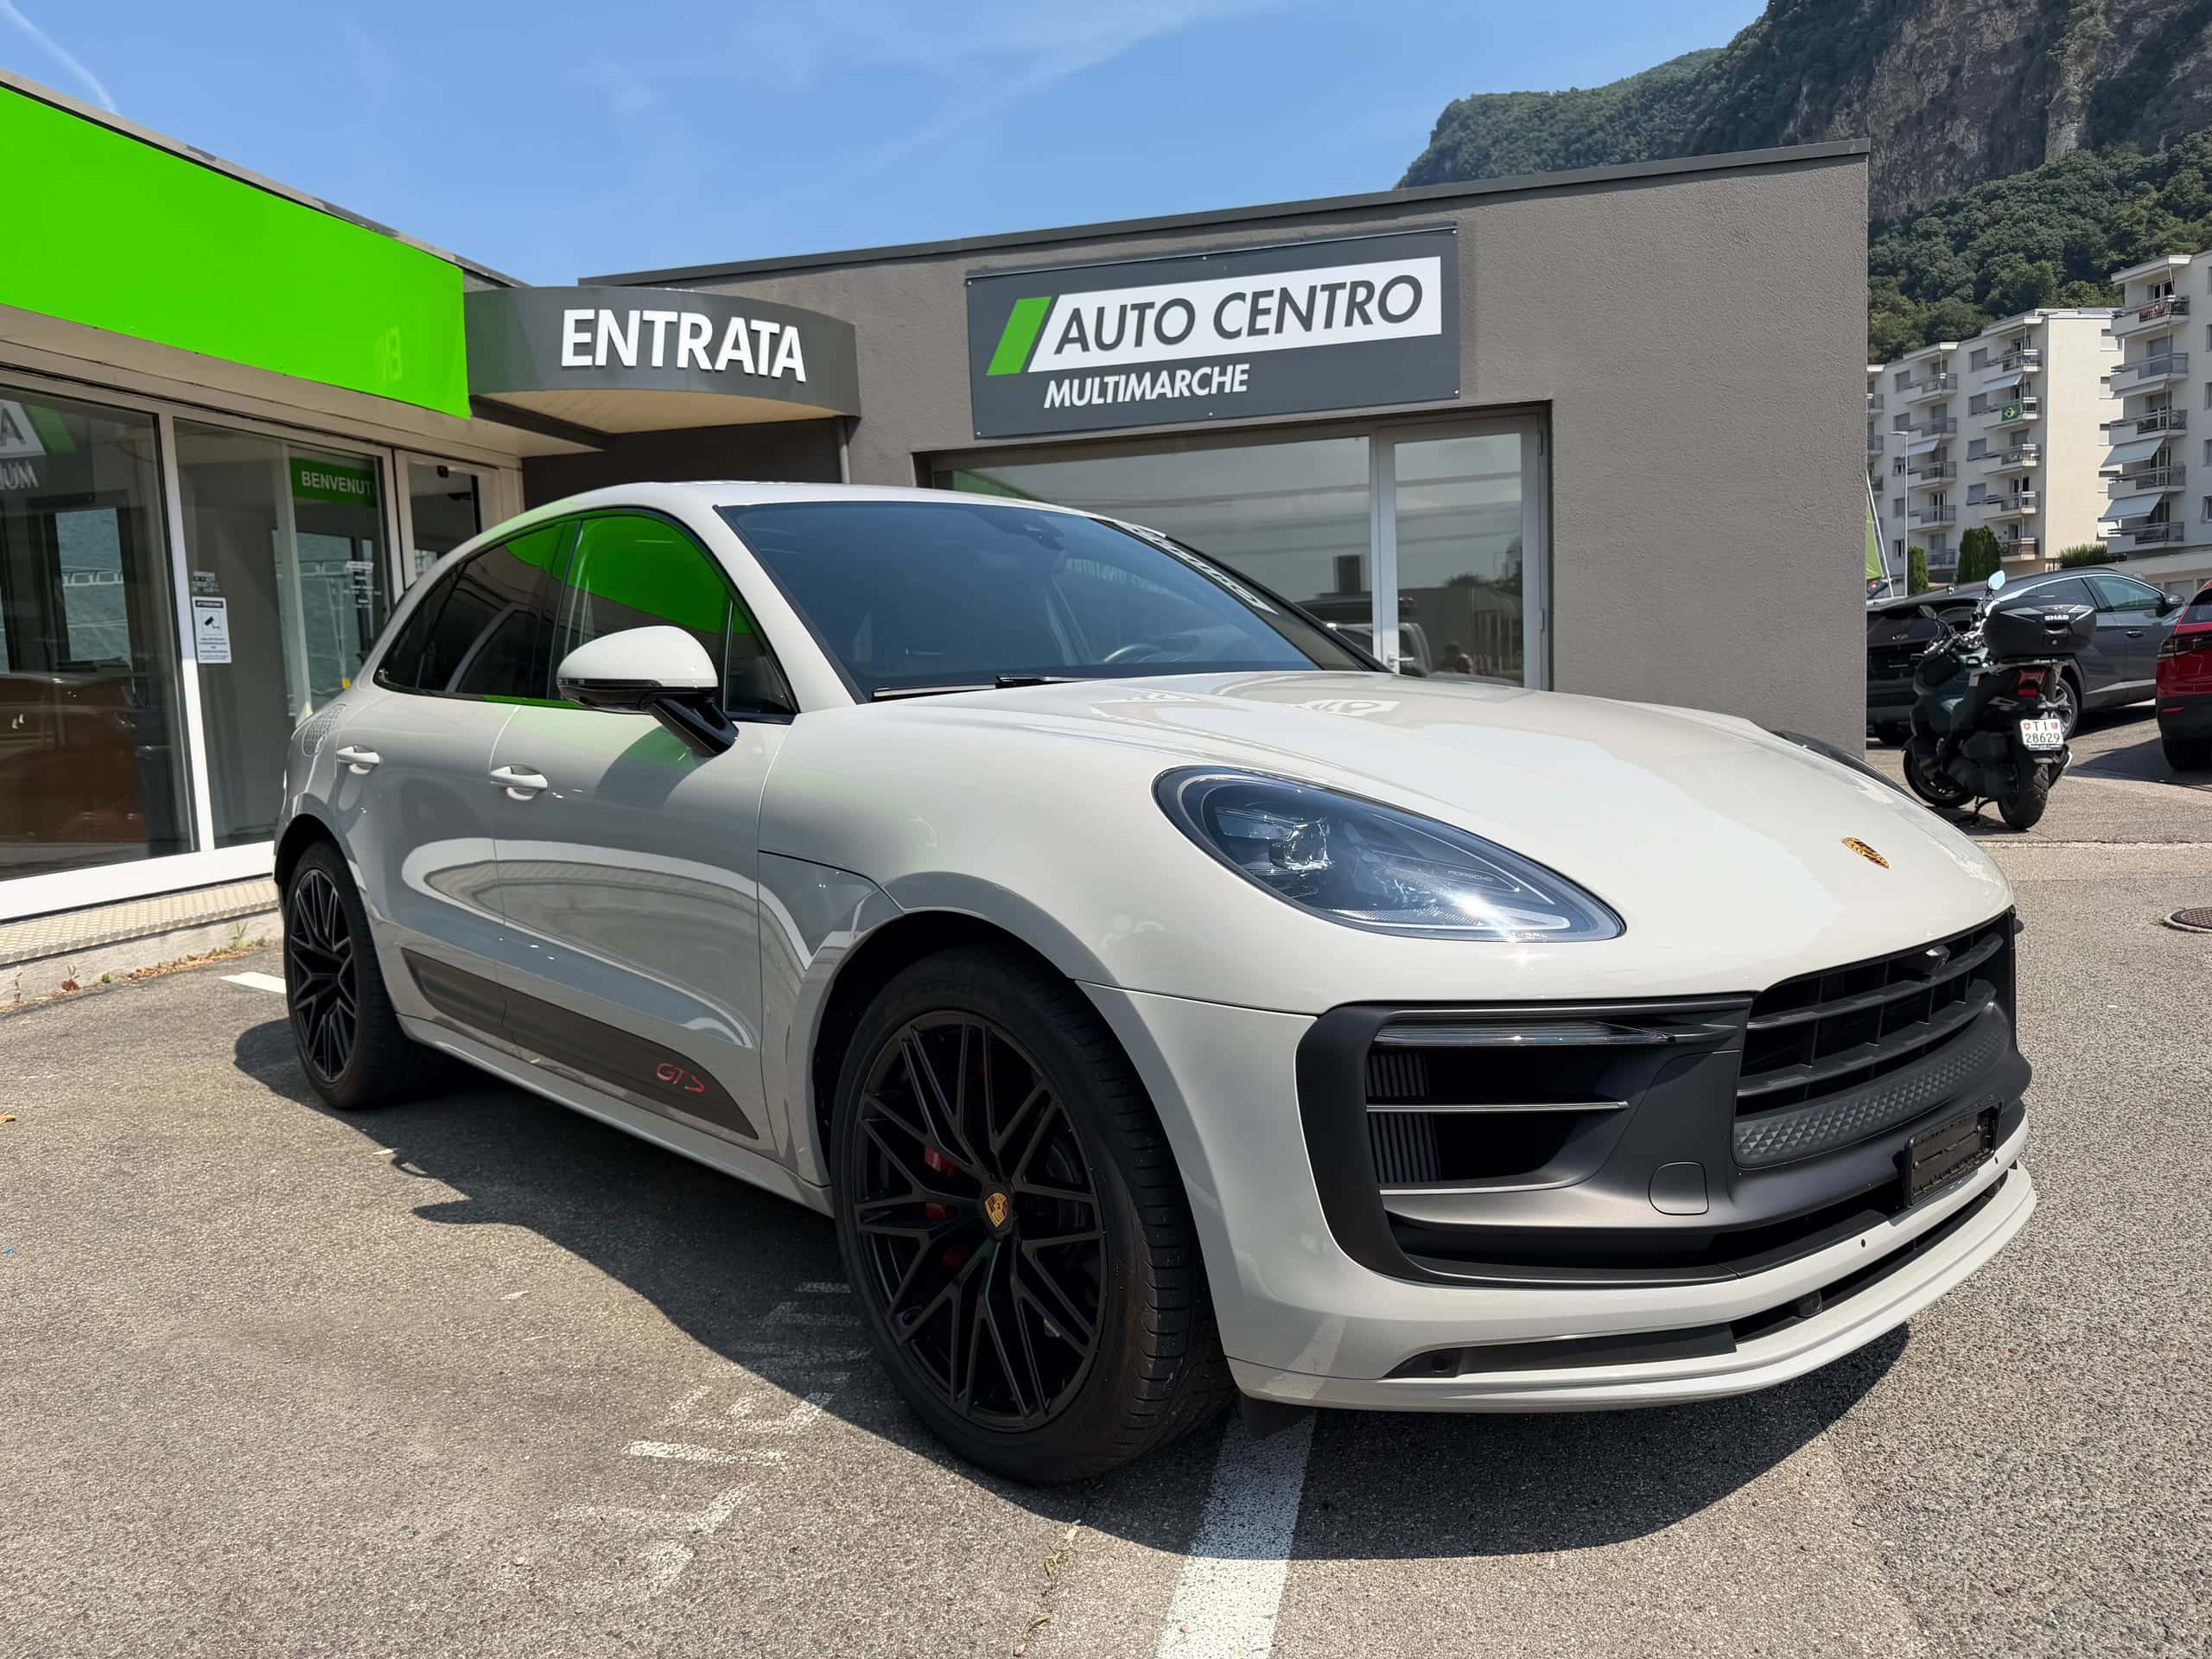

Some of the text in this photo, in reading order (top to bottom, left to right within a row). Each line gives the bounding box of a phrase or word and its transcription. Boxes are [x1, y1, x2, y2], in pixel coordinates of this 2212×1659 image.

[1053, 274, 1424, 355] AUTO CENTRO
[561, 308, 807, 382] ENTRATA
[1043, 363, 1251, 409] MULTIMARCHE
[301, 470, 374, 497] BENVENUT
[2024, 732, 2061, 744] 28629
[657, 1063, 705, 1093] GTS
